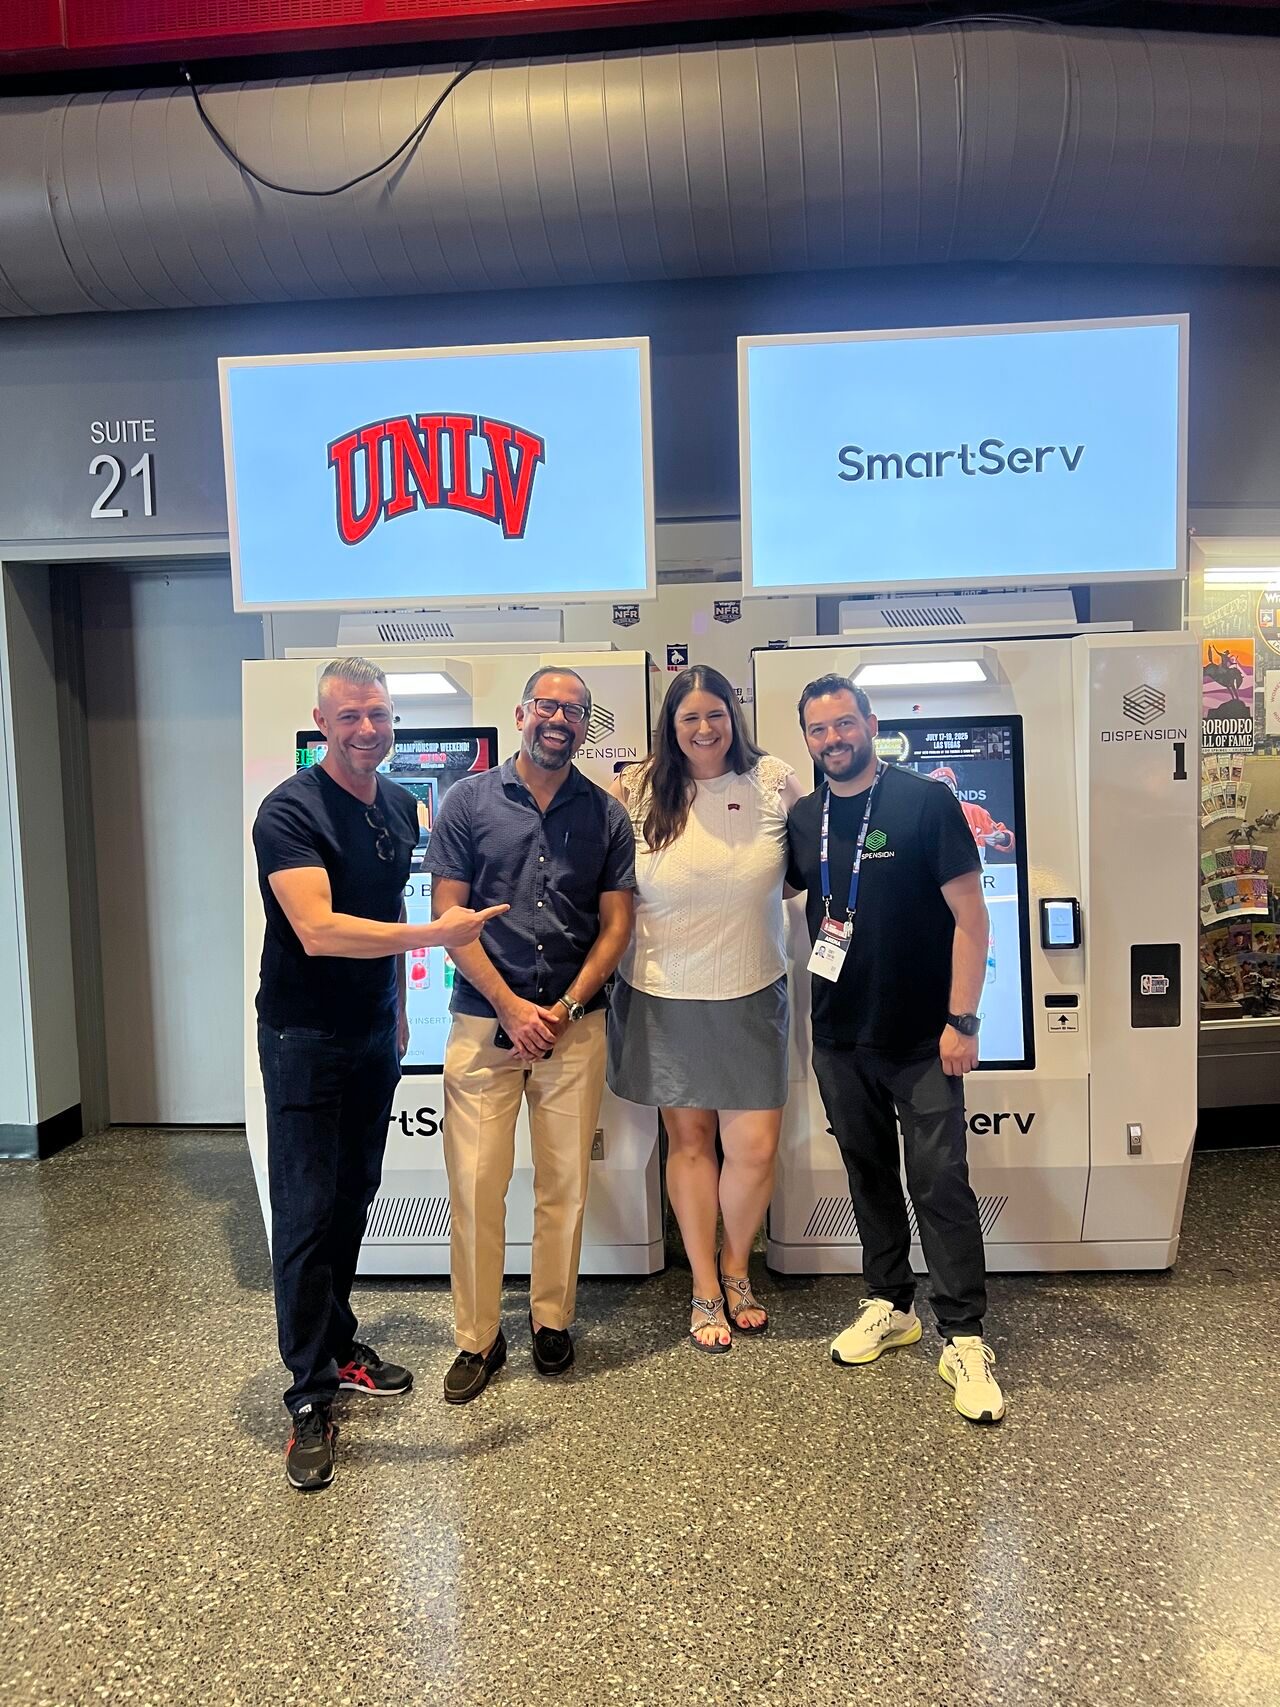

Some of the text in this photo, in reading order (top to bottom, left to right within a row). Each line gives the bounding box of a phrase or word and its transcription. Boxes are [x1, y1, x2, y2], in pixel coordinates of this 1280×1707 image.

[91, 419, 156, 444] SUITE
[838, 439, 1085, 481] SmartServ
[89, 452, 154, 518] 21
[327, 413, 545, 546] UNLV
[615, 610, 638, 619] NFR
[715, 606, 739, 615] NFR
[1101, 728, 1188, 742] DISPENSION
[1215, 735, 1227, 747] OF
[1228, 734, 1252, 747] FAME
[395, 742, 470, 753] CHAMPIONSHIP WEEKEND!
[933, 740, 961, 749] LAS VEGAS
[1172, 742, 1188, 780] 1
